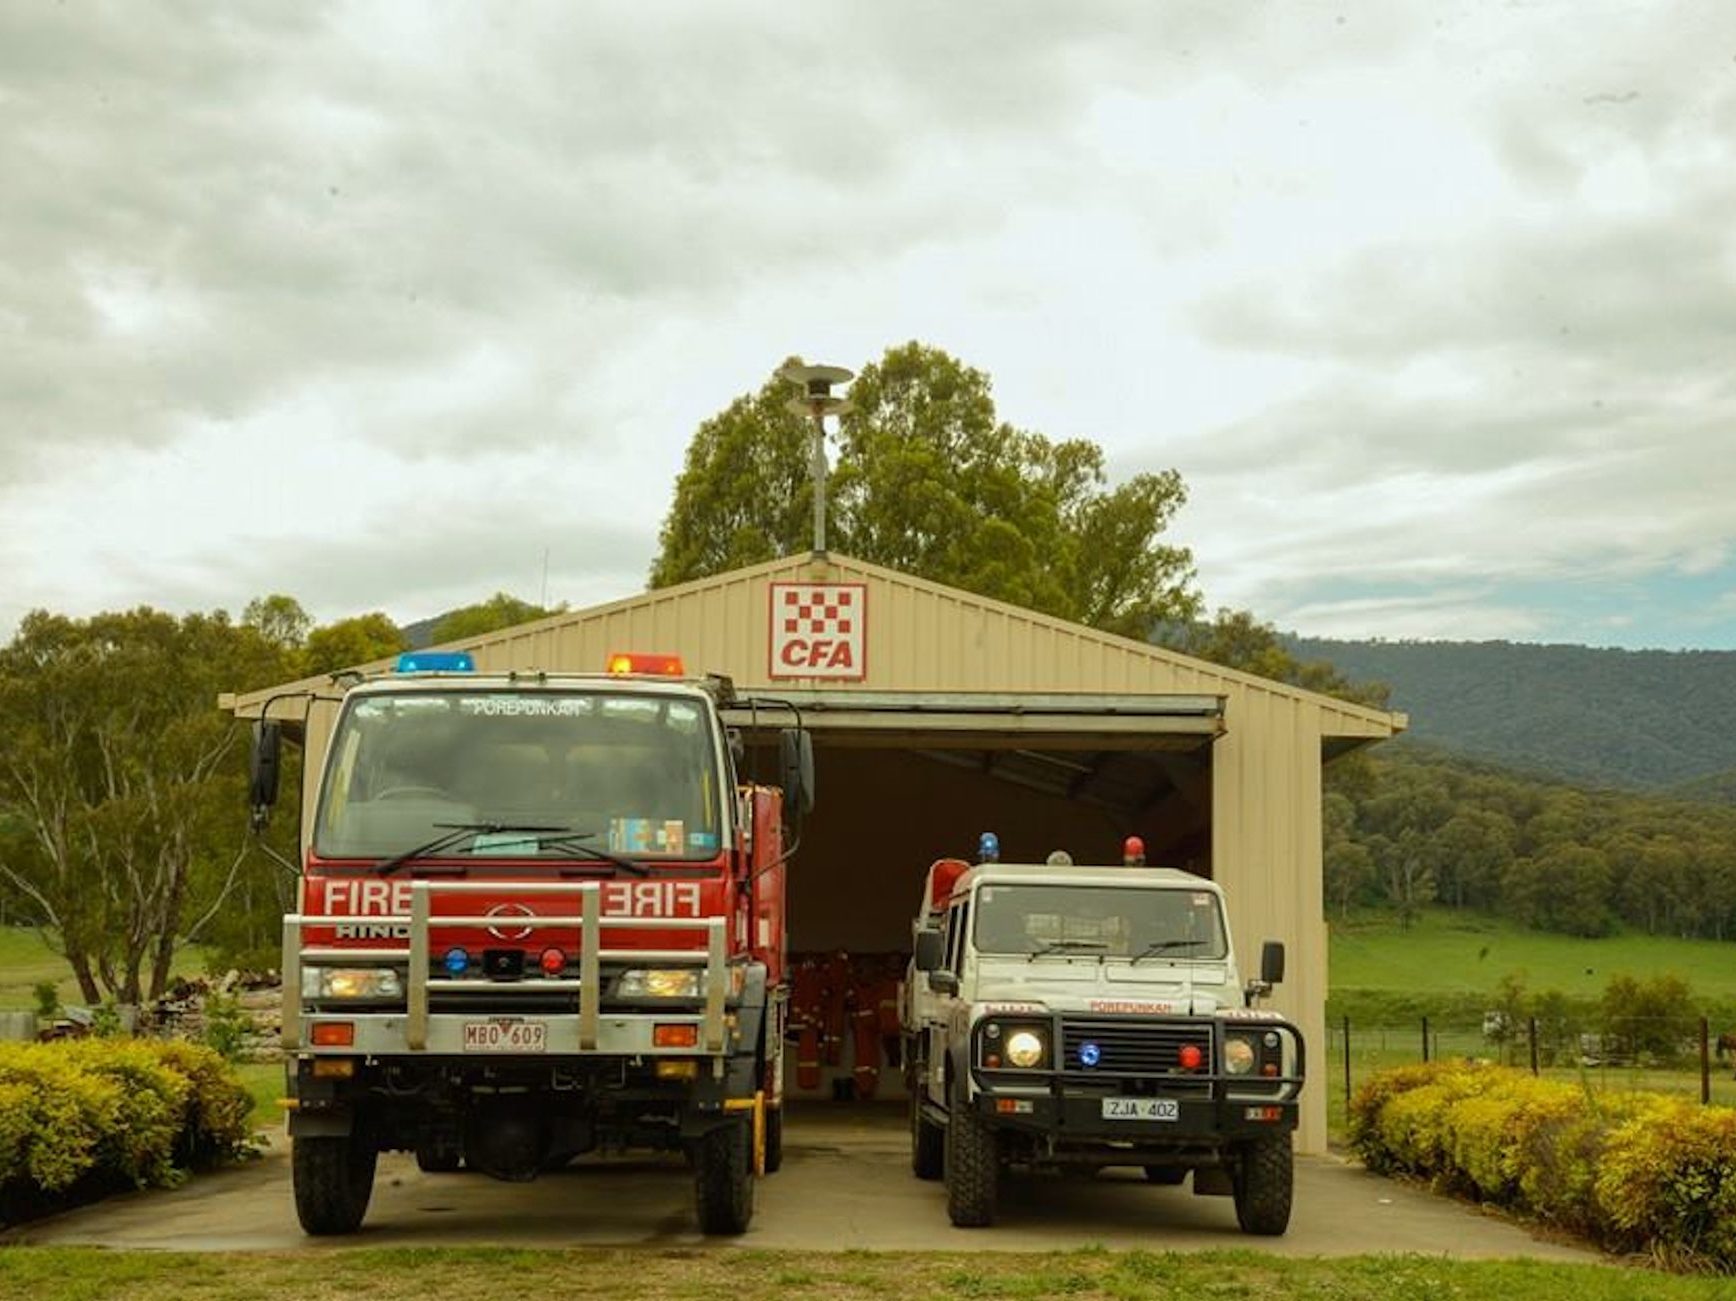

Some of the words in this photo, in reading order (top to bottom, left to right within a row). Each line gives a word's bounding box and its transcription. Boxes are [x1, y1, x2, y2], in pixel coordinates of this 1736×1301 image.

[781, 640, 852, 667] CFA
[325, 881, 412, 915] FIRE
[511, 1027, 542, 1044] 609
[1110, 1101, 1138, 1115] ZJA
[1147, 1103, 1176, 1117] 402
